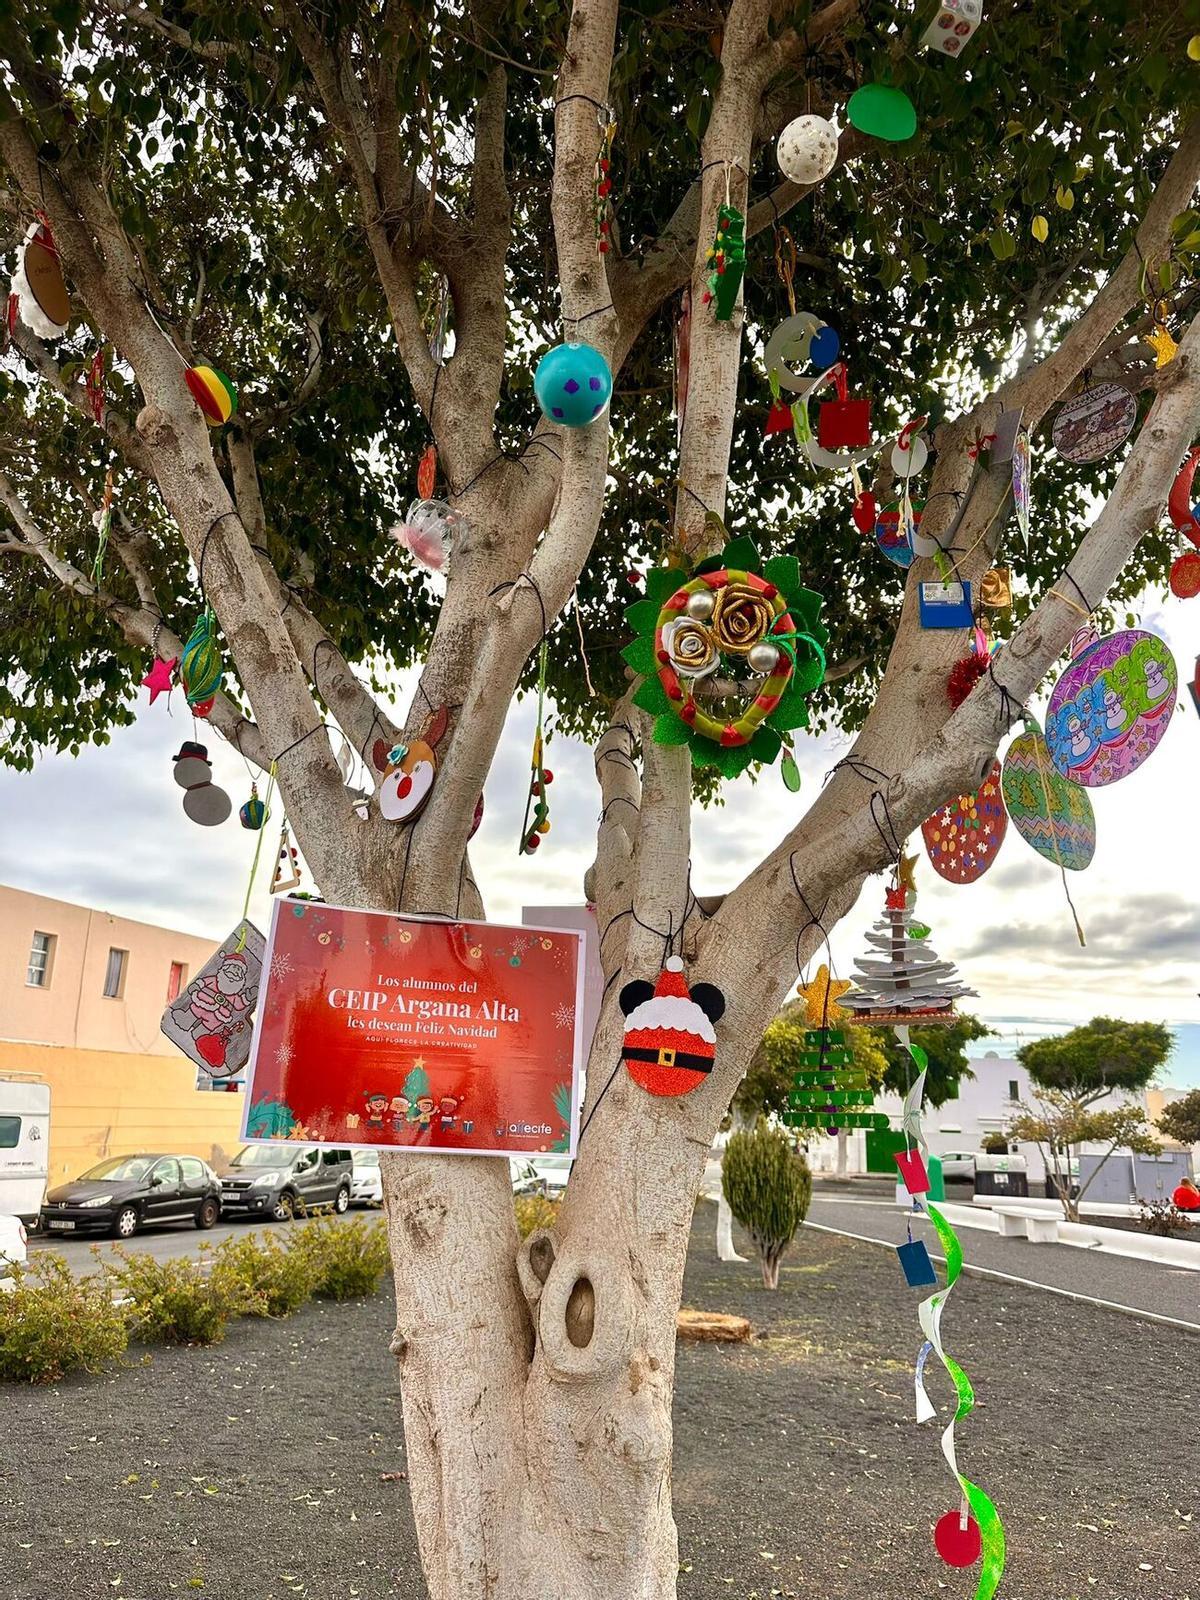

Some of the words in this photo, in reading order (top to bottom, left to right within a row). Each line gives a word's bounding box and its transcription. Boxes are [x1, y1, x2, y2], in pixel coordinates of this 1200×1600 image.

[377, 974, 400, 987] Los
[402, 976, 456, 992] alumnos
[458, 981, 478, 994] del
[328, 988, 387, 1012] CEIP
[391, 994, 471, 1019] Argana
[476, 1000, 520, 1023] Alta
[347, 1015, 365, 1030] les
[368, 1017, 412, 1032] desean
[415, 1021, 445, 1035] Feliz
[448, 1024, 498, 1039] Navidad
[431, 1041, 478, 1049] CREATIVIDAD
